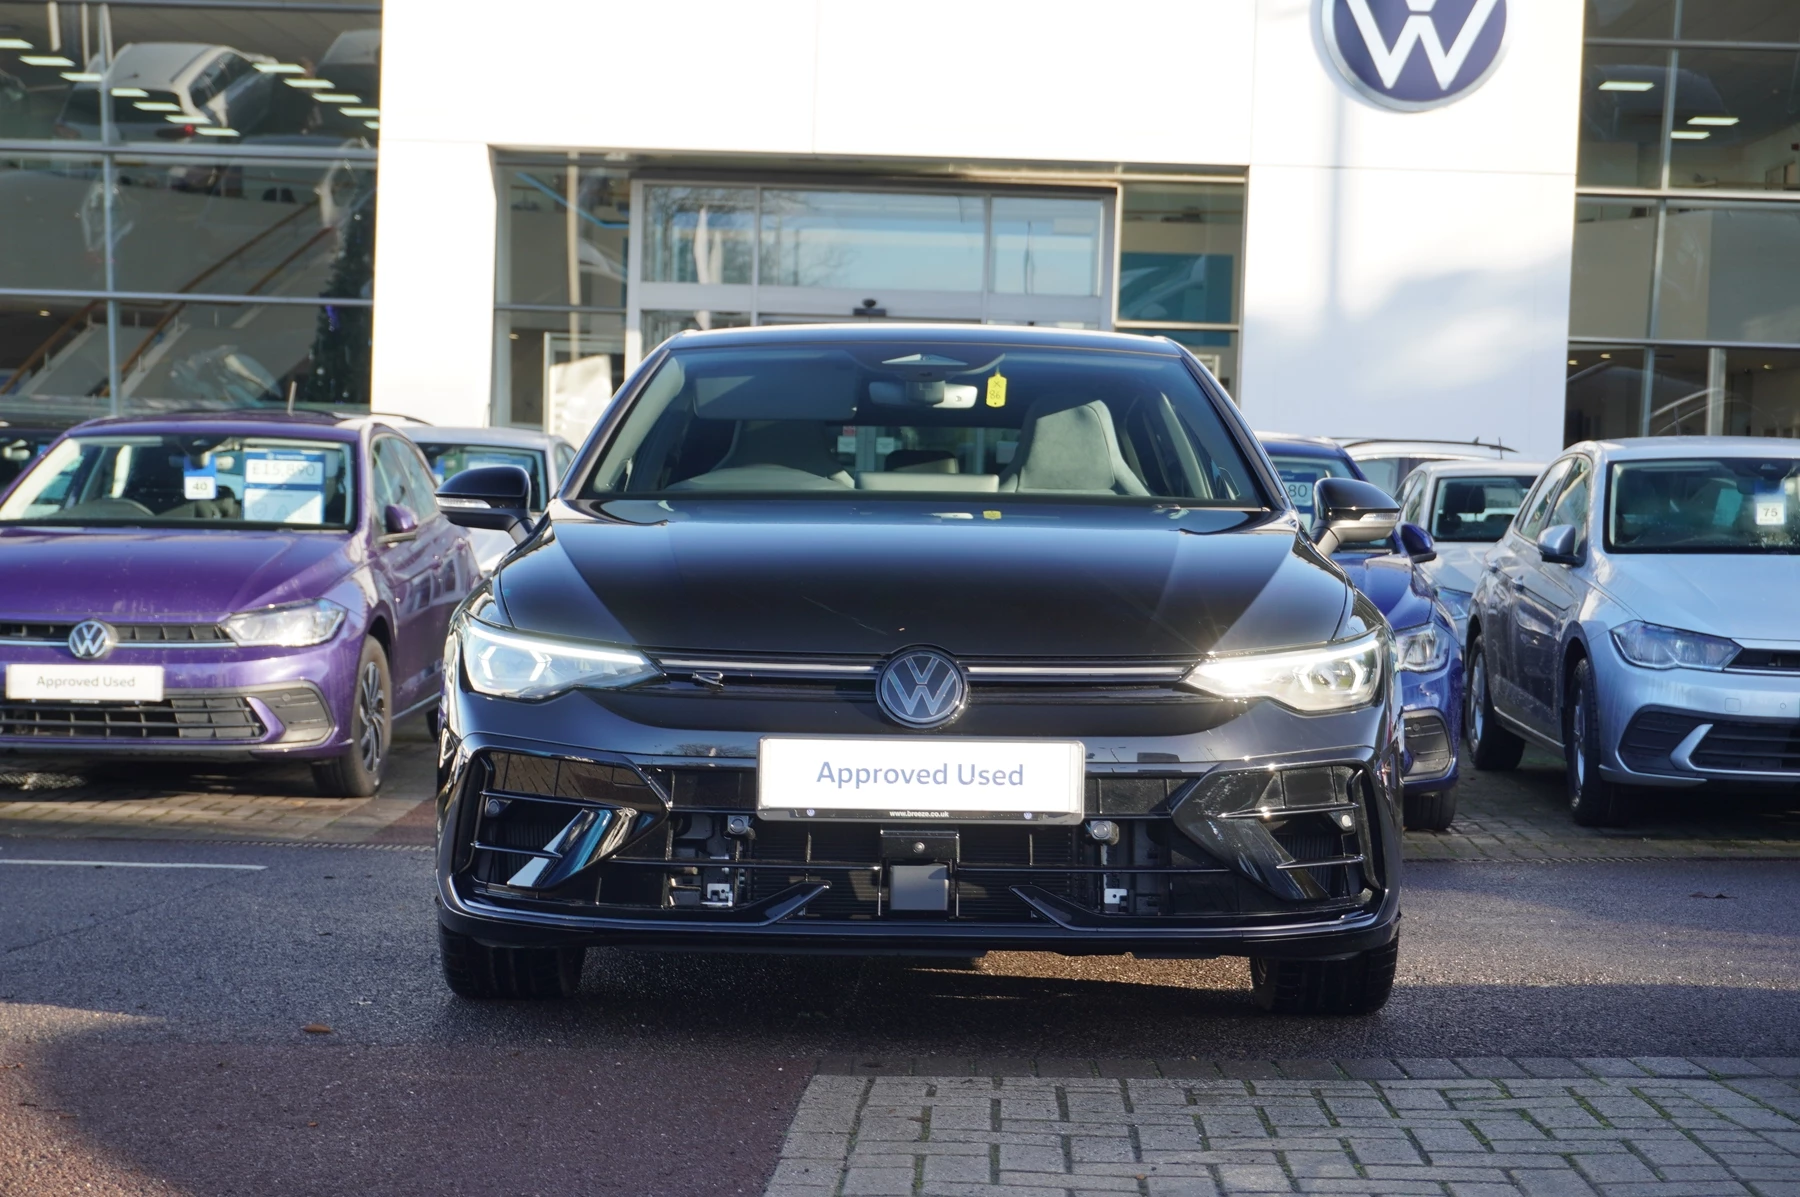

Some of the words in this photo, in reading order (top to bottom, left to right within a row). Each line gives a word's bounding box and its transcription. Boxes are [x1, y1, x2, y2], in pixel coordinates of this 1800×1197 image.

[192, 482, 208, 491] 40
[1763, 507, 1778, 517] 75
[70, 622, 108, 658] VW
[36, 675, 99, 688] Approved
[103, 676, 136, 687] Used
[885, 653, 958, 718] VW
[816, 760, 948, 789] Approved
[957, 763, 1025, 786] Used
[889, 810, 949, 818] www.breeze.co.uk
